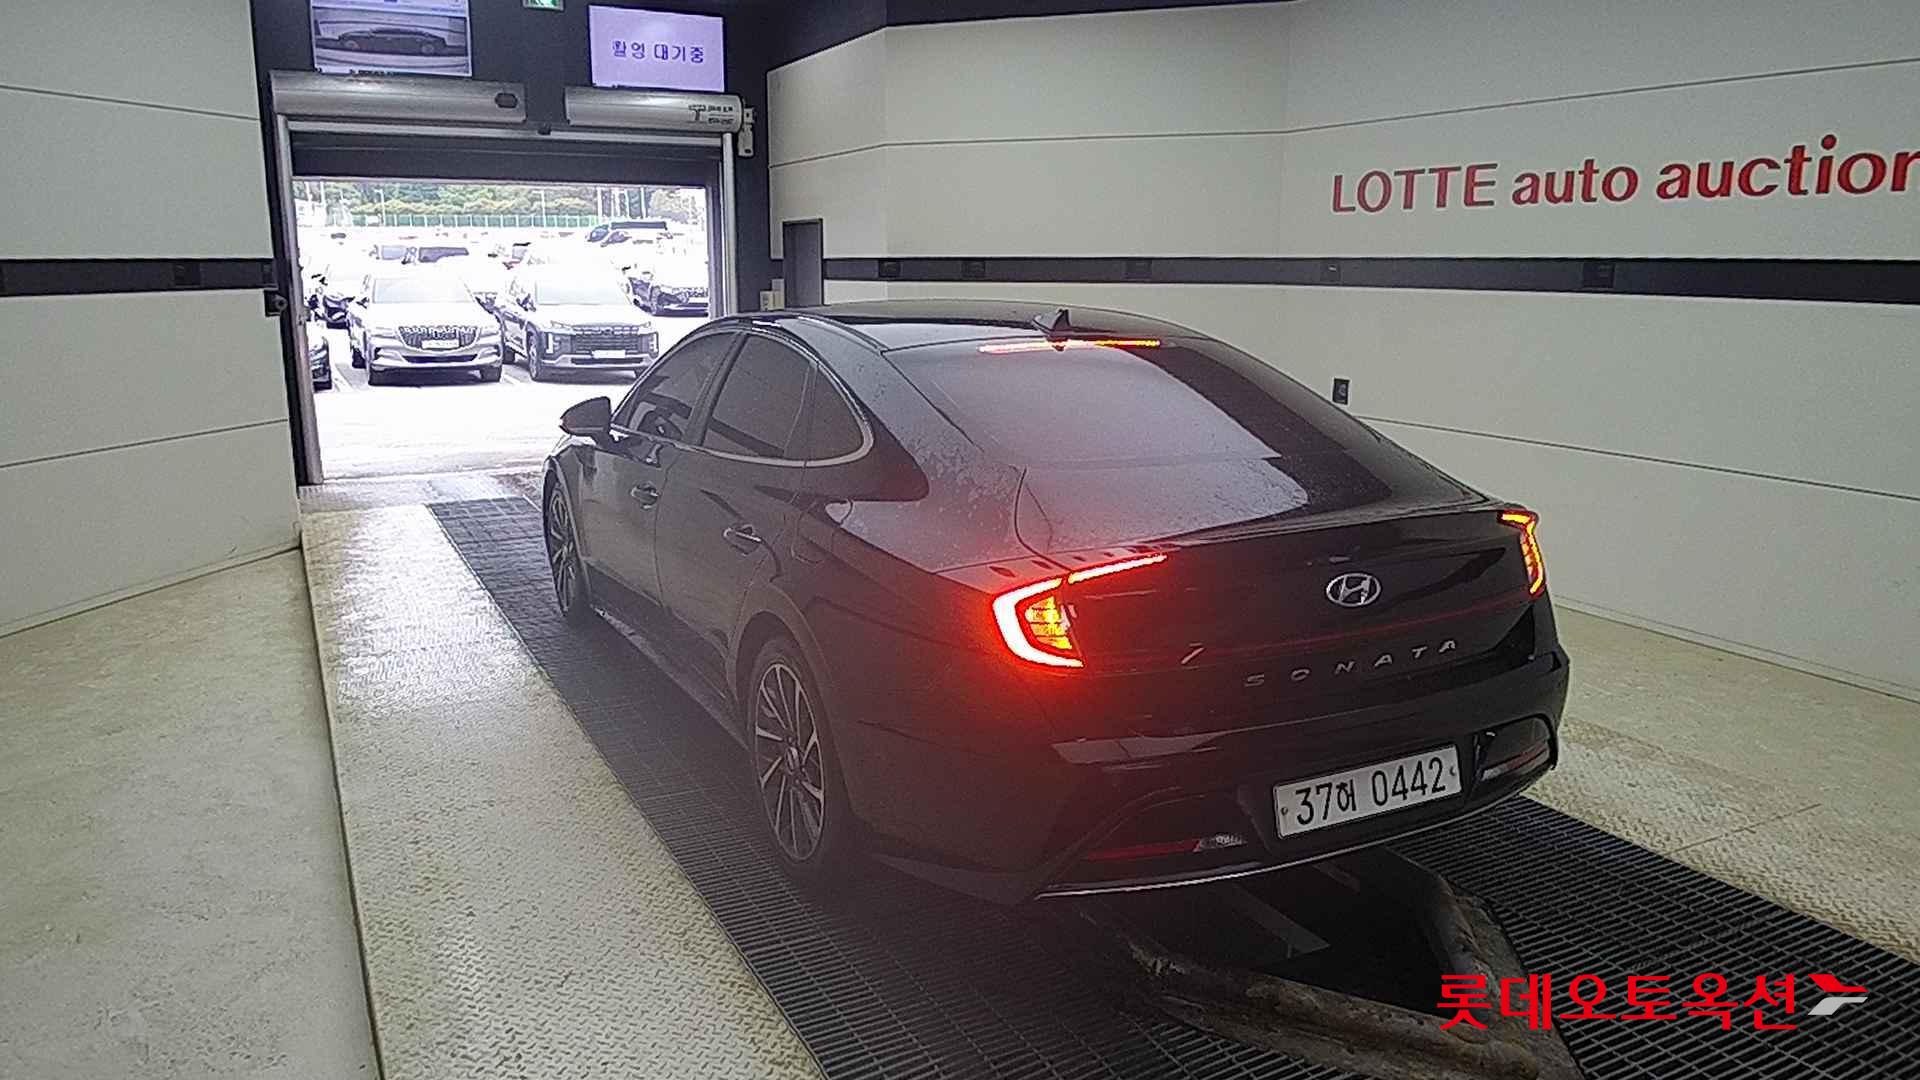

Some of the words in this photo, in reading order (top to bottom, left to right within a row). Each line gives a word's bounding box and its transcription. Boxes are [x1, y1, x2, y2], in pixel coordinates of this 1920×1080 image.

[653, 43, 704, 64] 대기중
[1332, 163, 1498, 212] LOTTE
[1512, 158, 1639, 205] auto
[1245, 640, 1456, 687] SONATA
[1295, 779, 1357, 826] 37허
[1371, 757, 1446, 806] 0442
